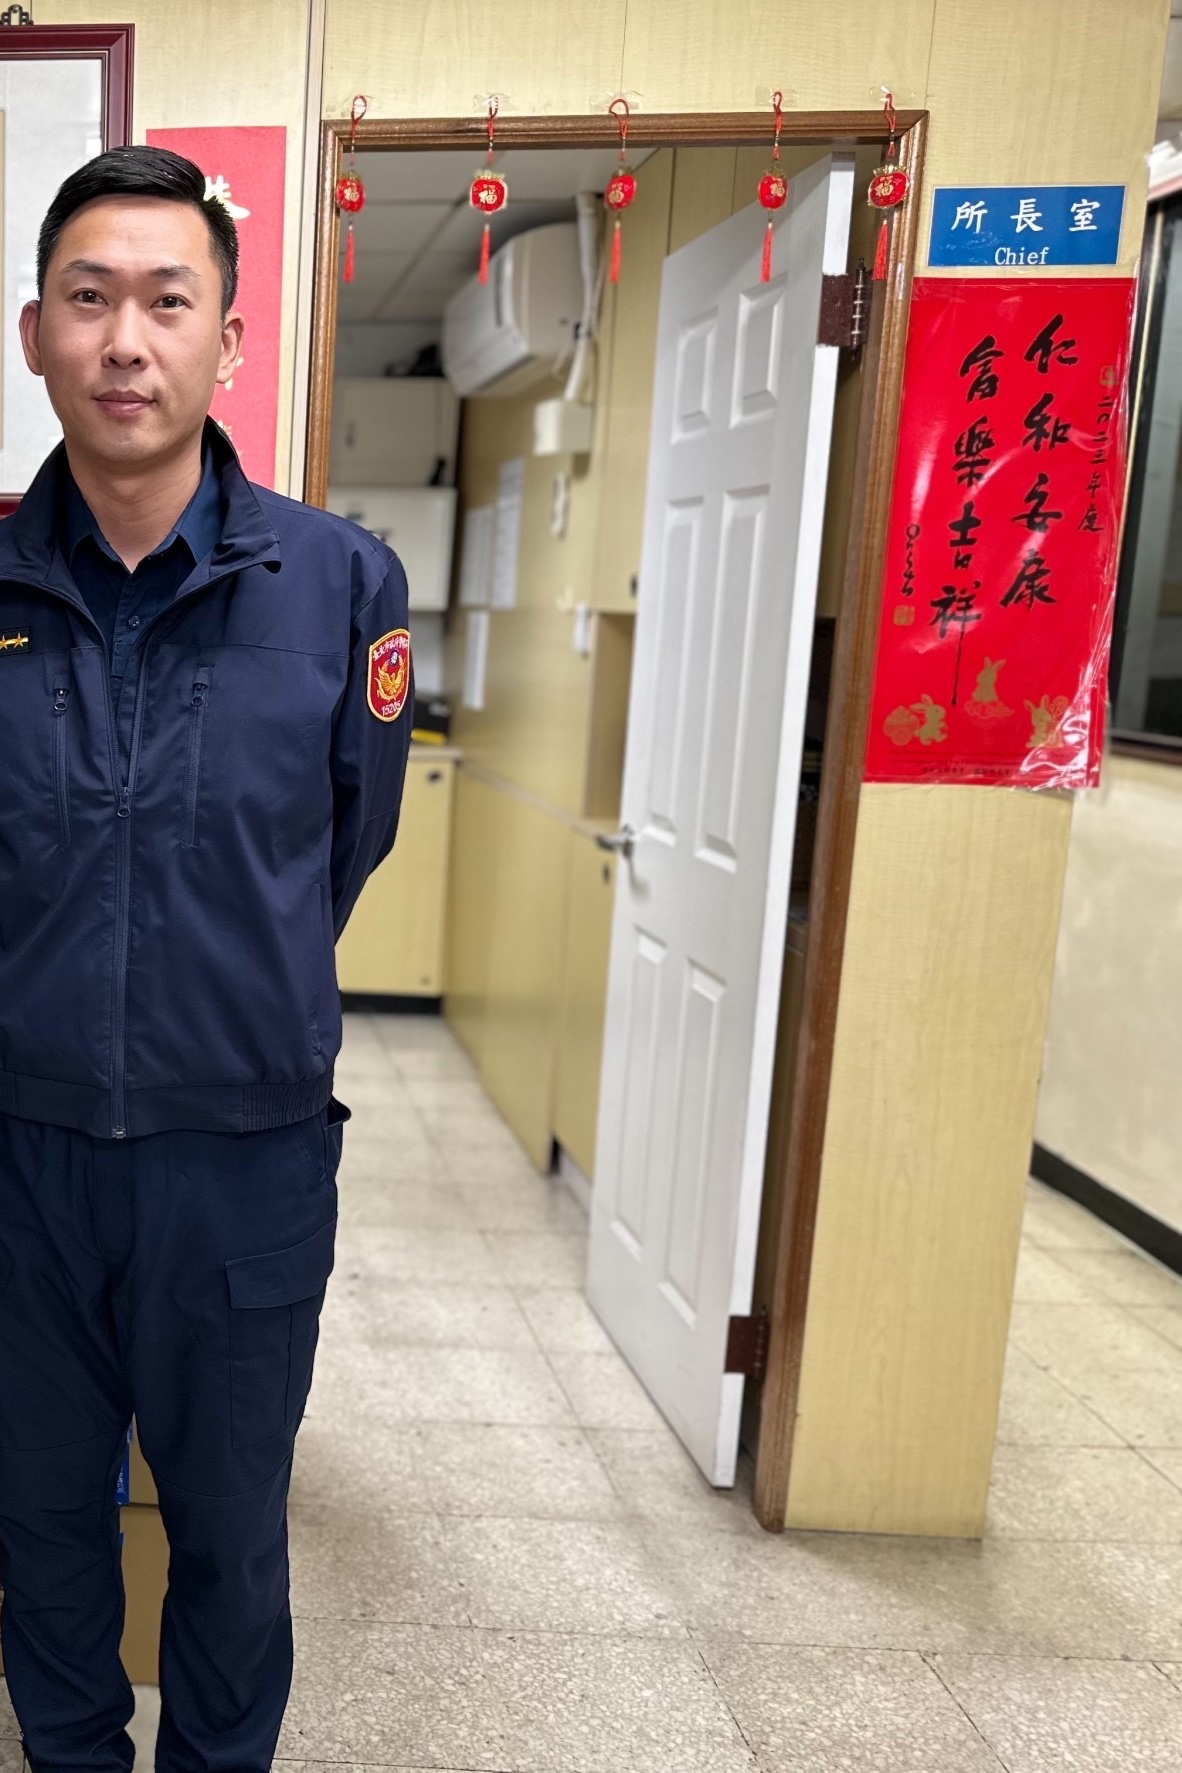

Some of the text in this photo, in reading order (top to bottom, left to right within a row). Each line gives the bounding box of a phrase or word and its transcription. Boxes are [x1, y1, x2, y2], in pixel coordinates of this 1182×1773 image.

[478, 184, 498, 205] 福
[951, 198, 1101, 234] 所長室
[994, 247, 1050, 266] Chief
[1000, 313, 1079, 607] 仁和安康
[929, 334, 1005, 707] 富樂吉祥
